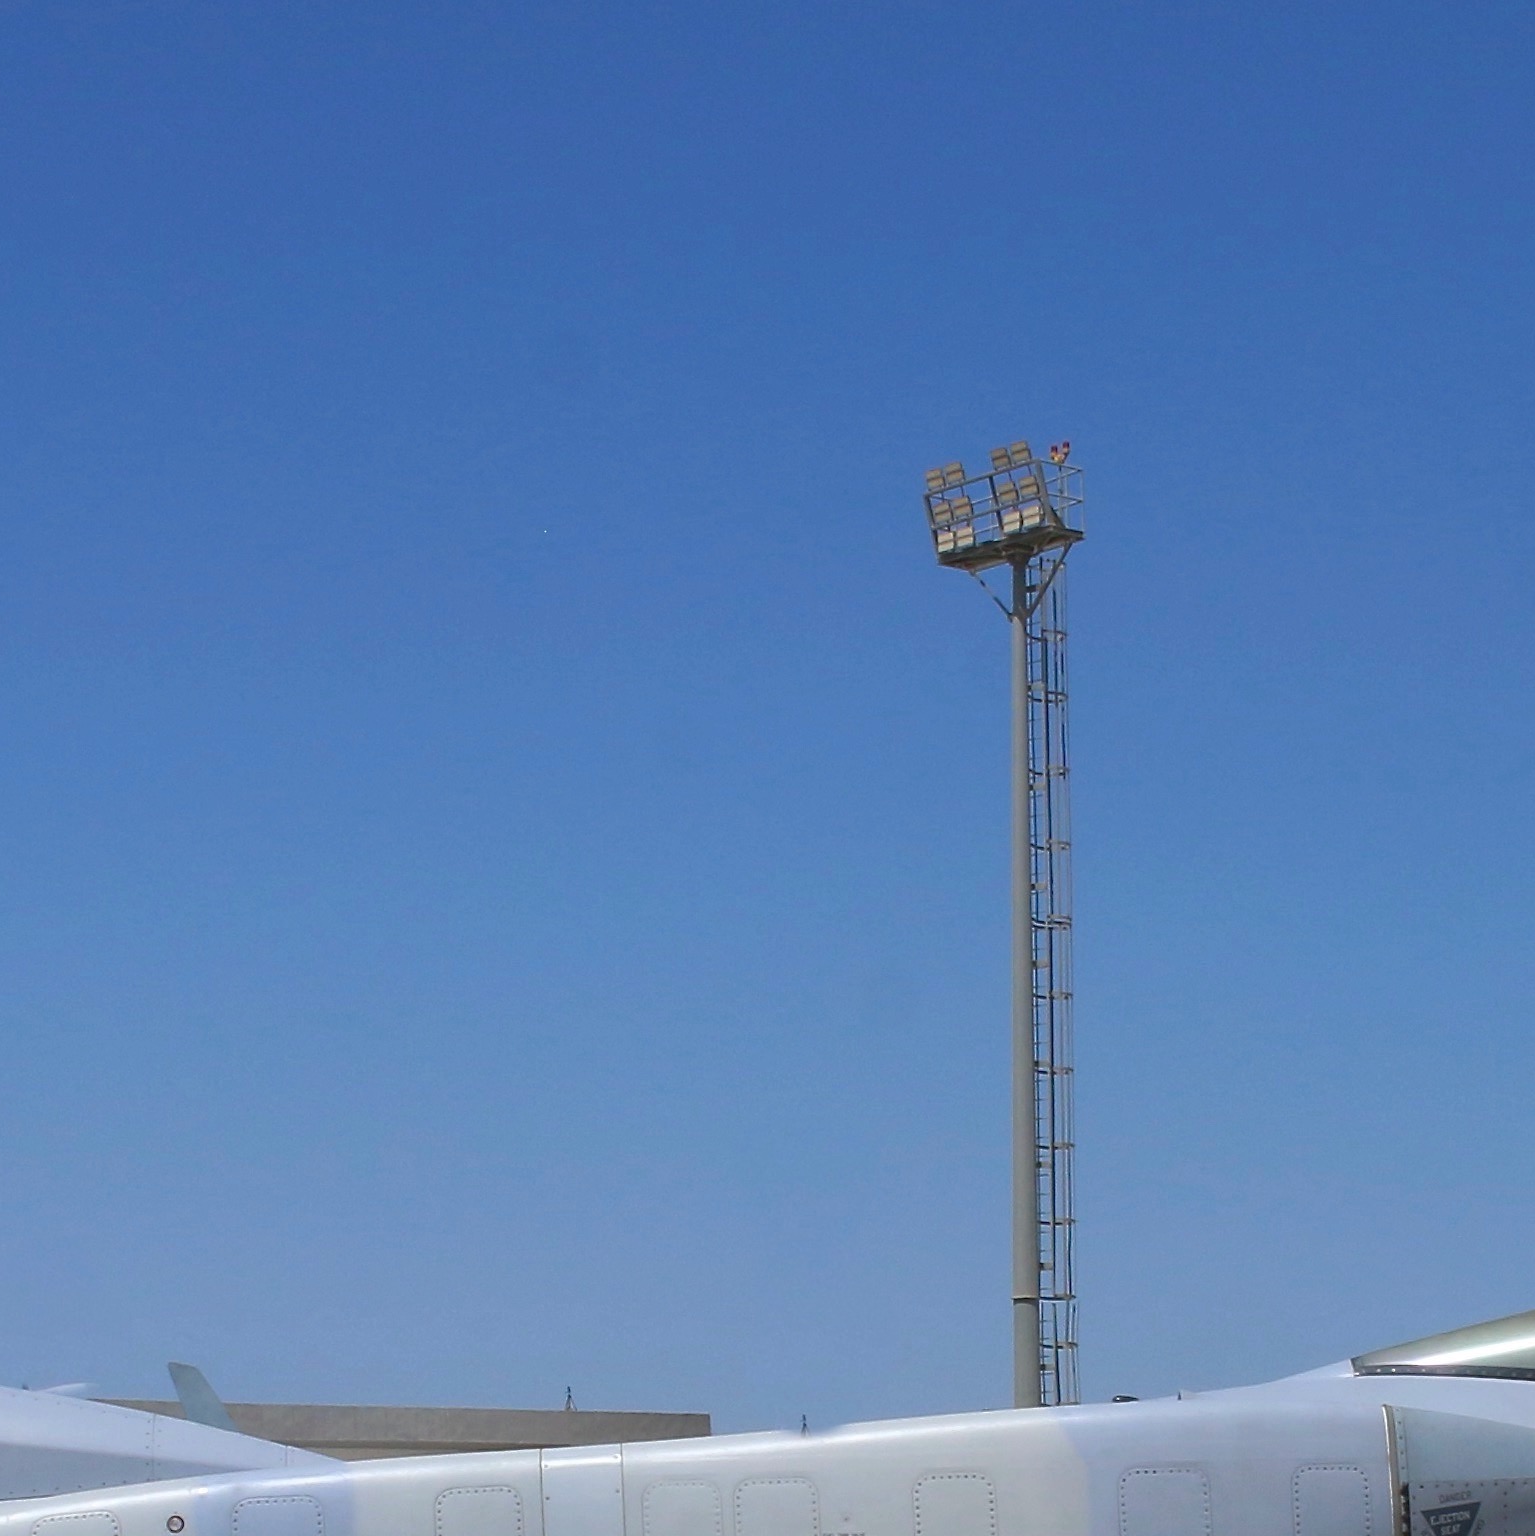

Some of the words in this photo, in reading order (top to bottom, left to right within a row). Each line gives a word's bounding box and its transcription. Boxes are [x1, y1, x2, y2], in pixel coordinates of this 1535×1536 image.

[1438, 1490, 1472, 1504] DANGER
[1430, 1511, 1471, 1526] EJECTION
[1441, 1524, 1461, 1536] SEAT
